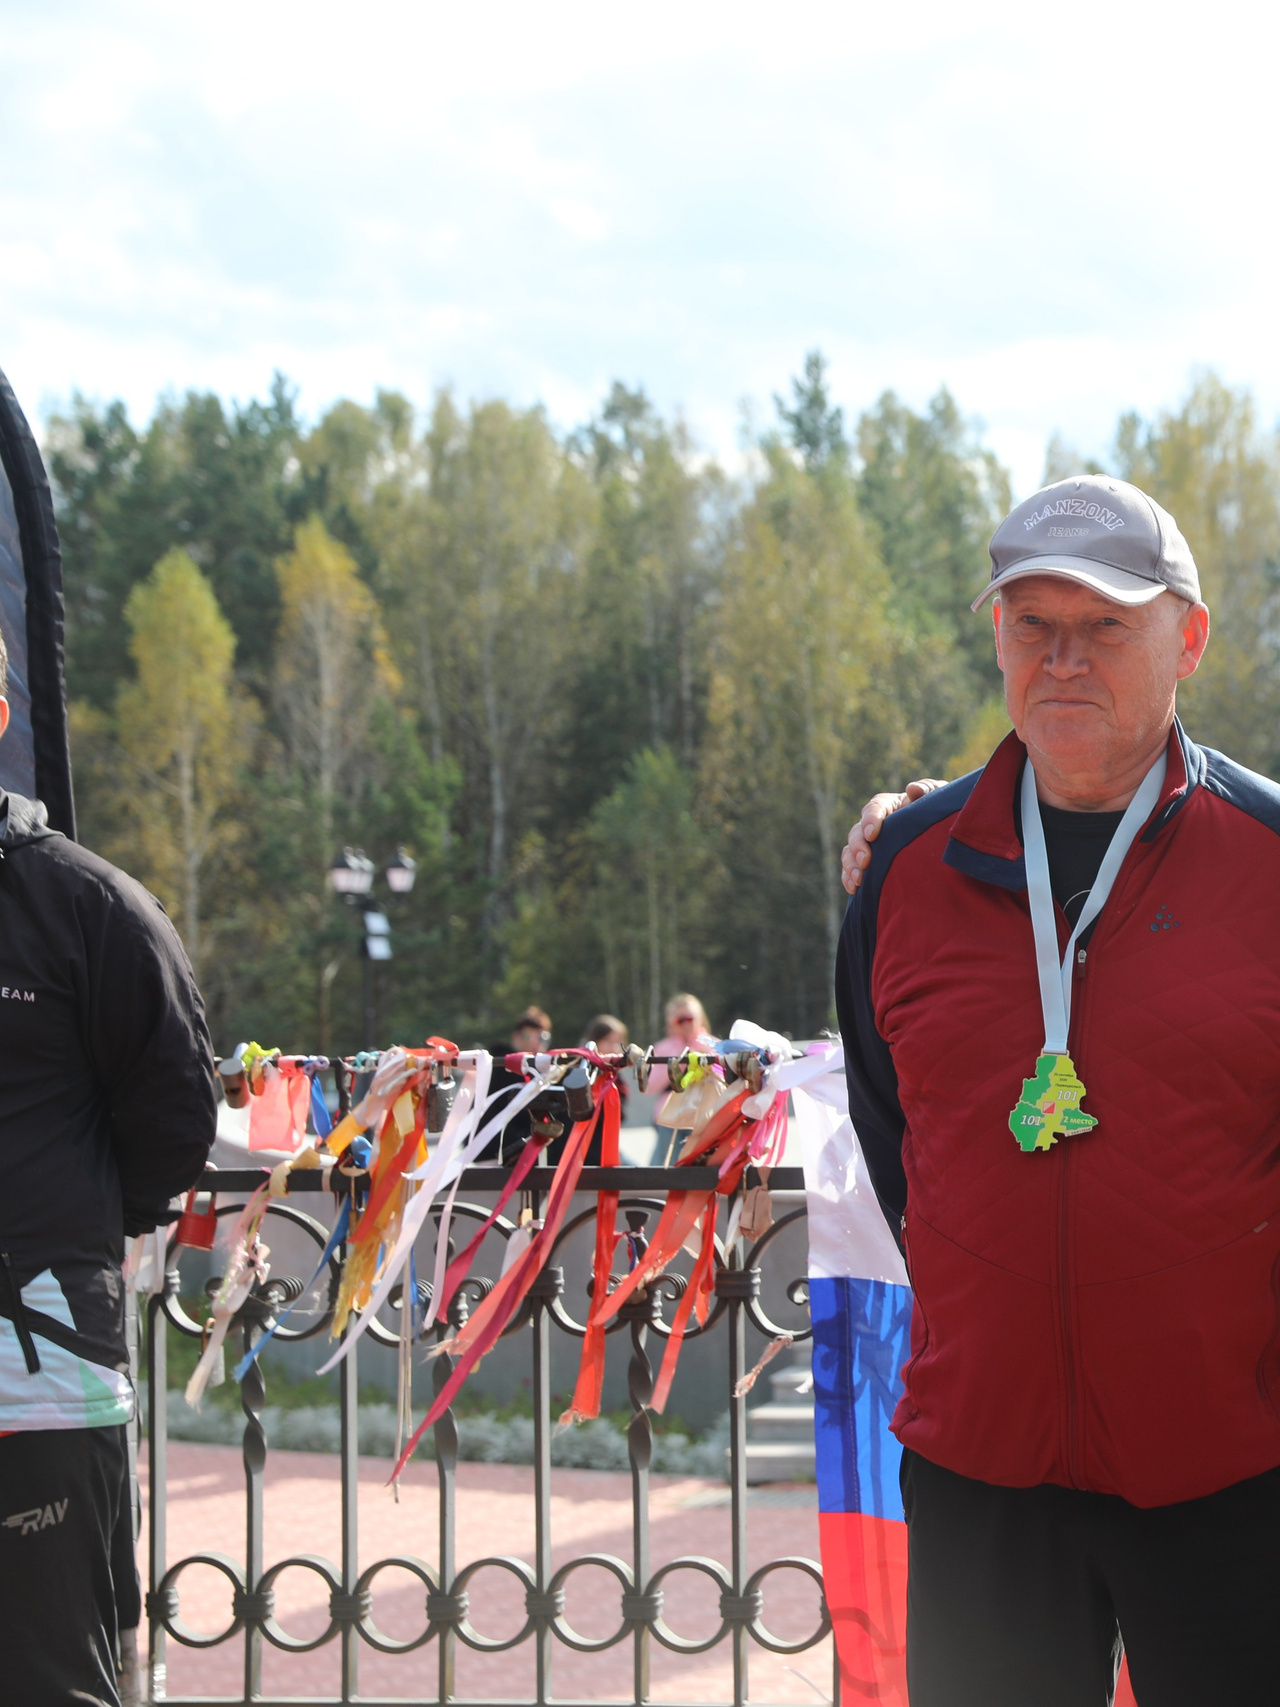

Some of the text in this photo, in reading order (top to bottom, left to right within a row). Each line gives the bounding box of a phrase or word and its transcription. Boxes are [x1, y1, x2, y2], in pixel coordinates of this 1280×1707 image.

[1023, 499, 1125, 531] MANZONI
[1048, 527, 1090, 538] JEANS
[0, 986, 36, 1003] EAM
[1057, 1090, 1078, 1101] 101
[1020, 1115, 1042, 1126] 101
[1, 1497, 69, 1536] RAY
